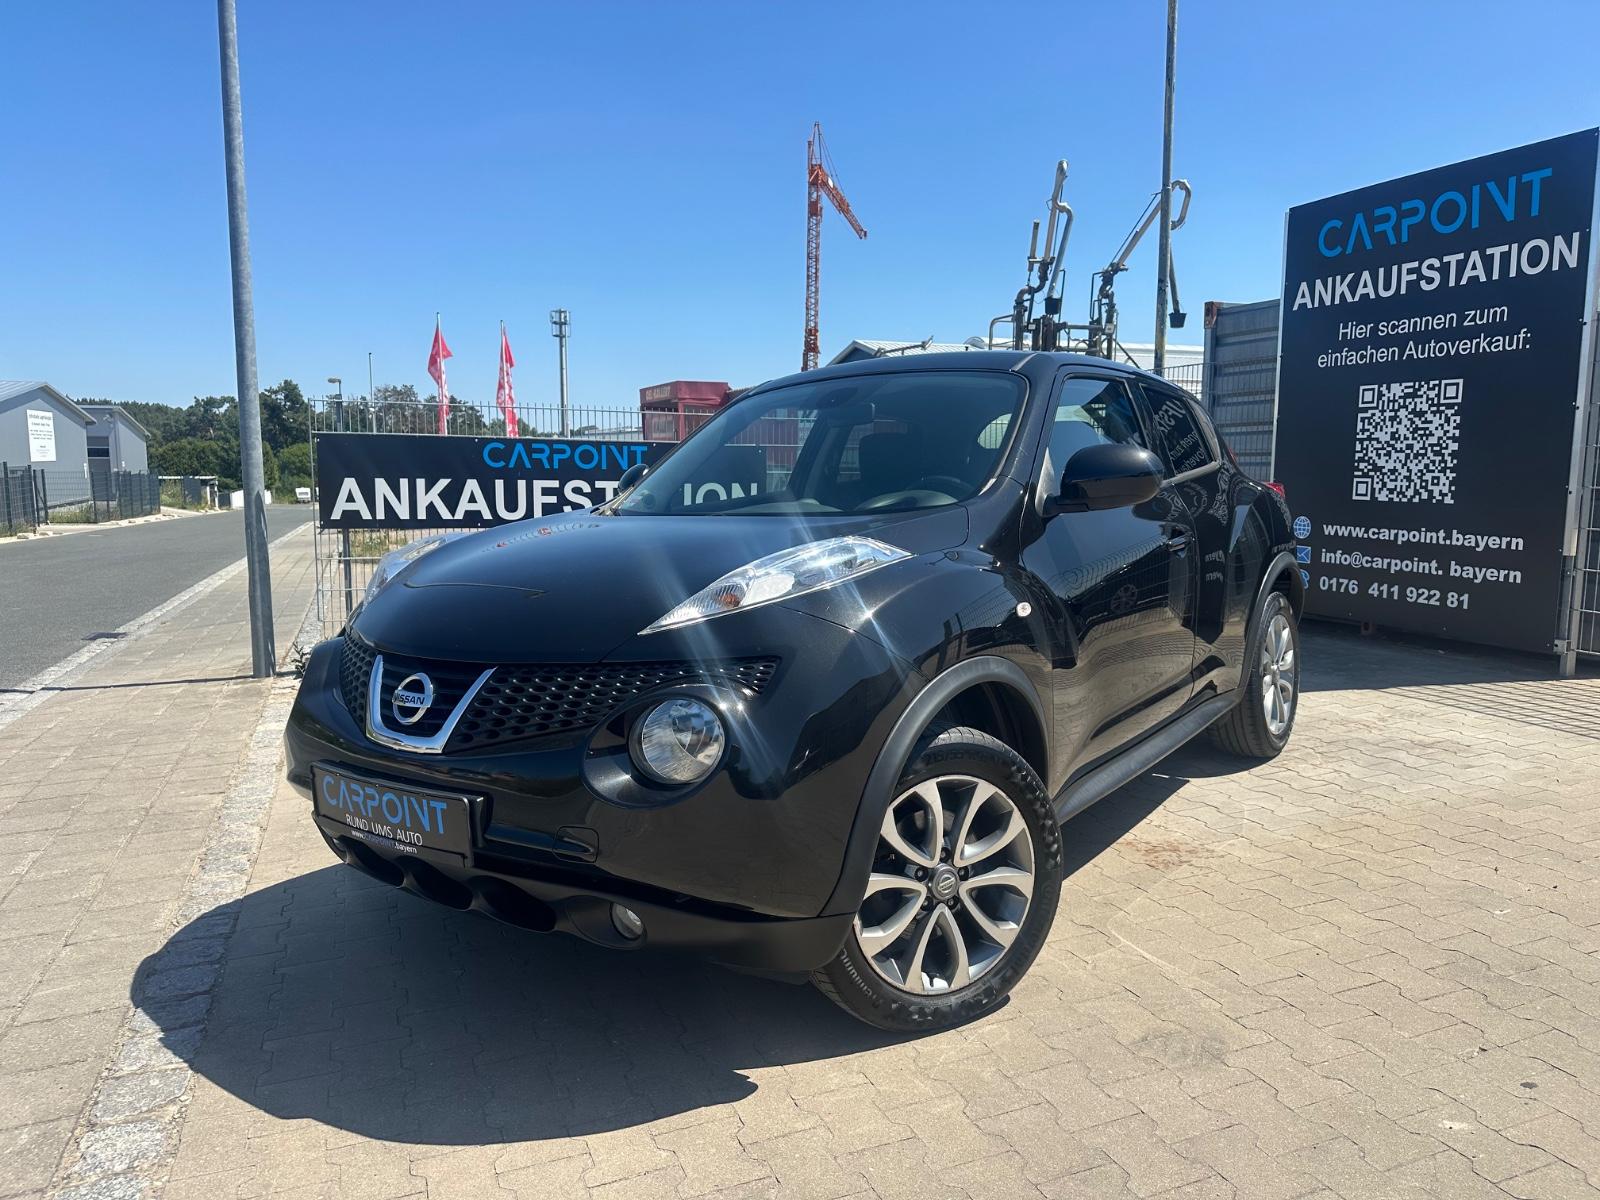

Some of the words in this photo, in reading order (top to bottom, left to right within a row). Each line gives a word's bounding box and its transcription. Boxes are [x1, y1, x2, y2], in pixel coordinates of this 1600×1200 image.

[1318, 167, 1553, 258] CARPOINT
[1292, 231, 1580, 311] ANKAUFSTATION
[1338, 320, 1374, 341] Hier
[1378, 311, 1457, 337] scannen
[1464, 305, 1508, 326] zum
[1317, 344, 1398, 368] einfachen
[1403, 329, 1532, 361] Autoverkauf:
[482, 441, 648, 470] CARPOINT
[1323, 523, 1524, 552] www.carpoint.bayern
[1449, 561, 1523, 584] bayern
[1319, 576, 1359, 594] 0176
[1368, 582, 1400, 600] 411
[1406, 587, 1441, 606] 922
[1446, 591, 1470, 610] 81
[322, 774, 448, 835] CARPOINT
[345, 813, 369, 831] RUND
[371, 821, 393, 839] UMS
[396, 828, 423, 846] AUTO
